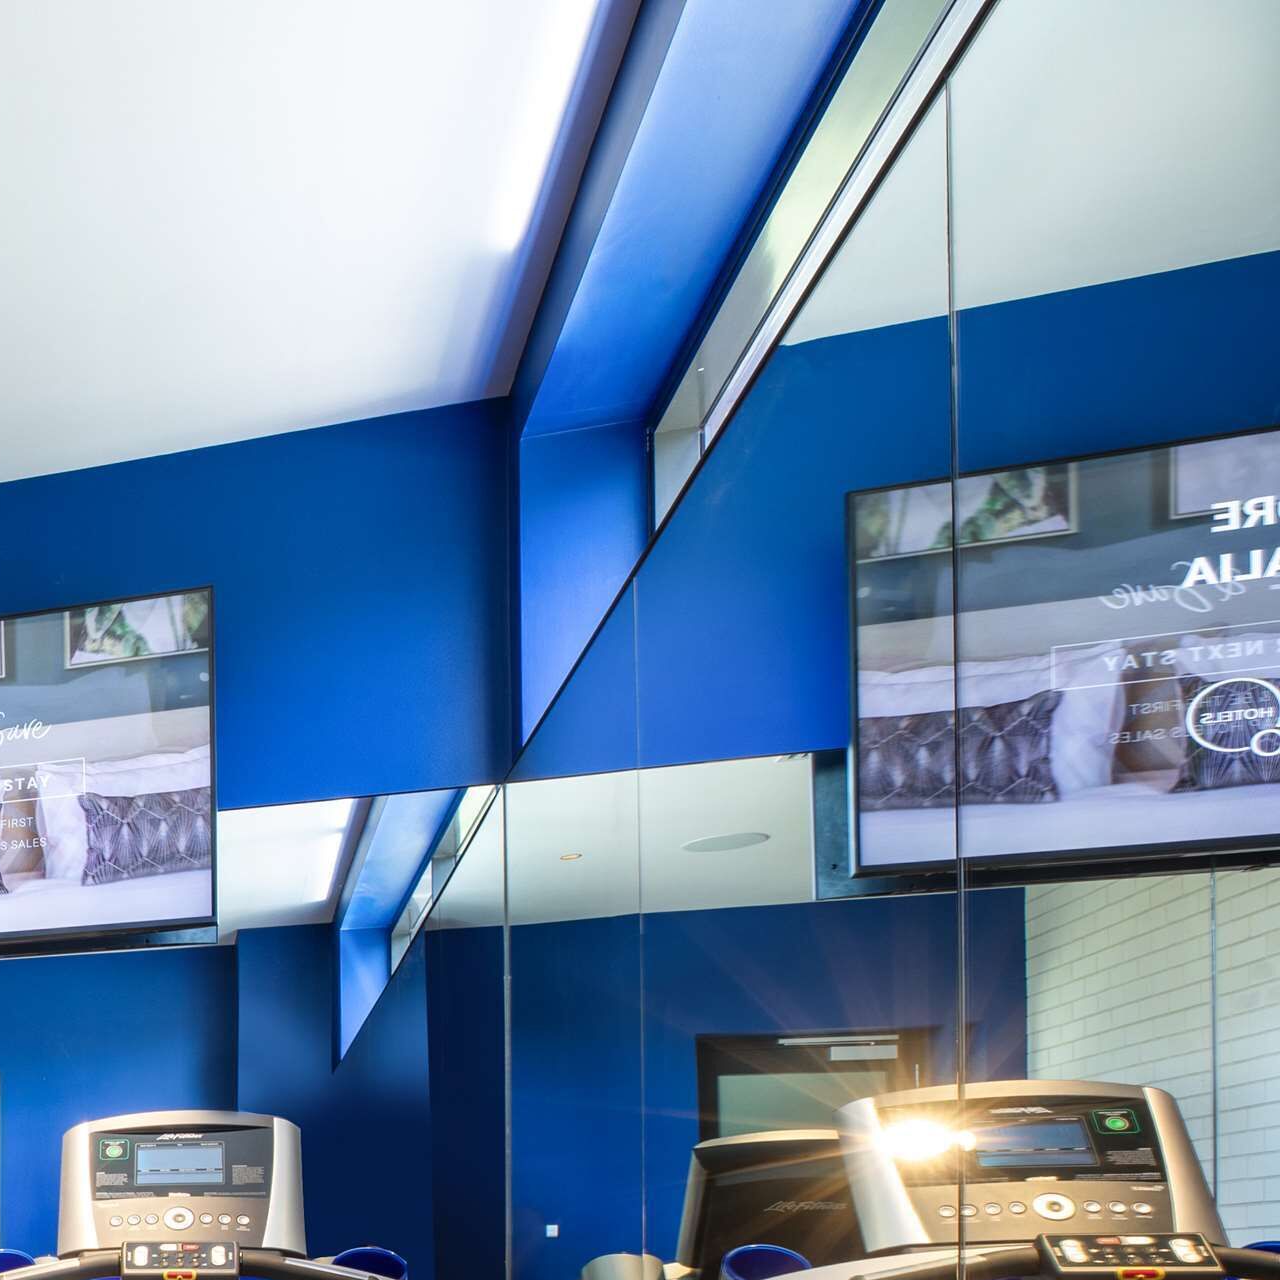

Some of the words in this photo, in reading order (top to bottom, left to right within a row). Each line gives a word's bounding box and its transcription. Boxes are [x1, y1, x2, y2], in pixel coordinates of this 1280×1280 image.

[4, 774, 51, 793] STAY
[1, 817, 34, 829] FIRST
[10, 837, 47, 850] SALES
